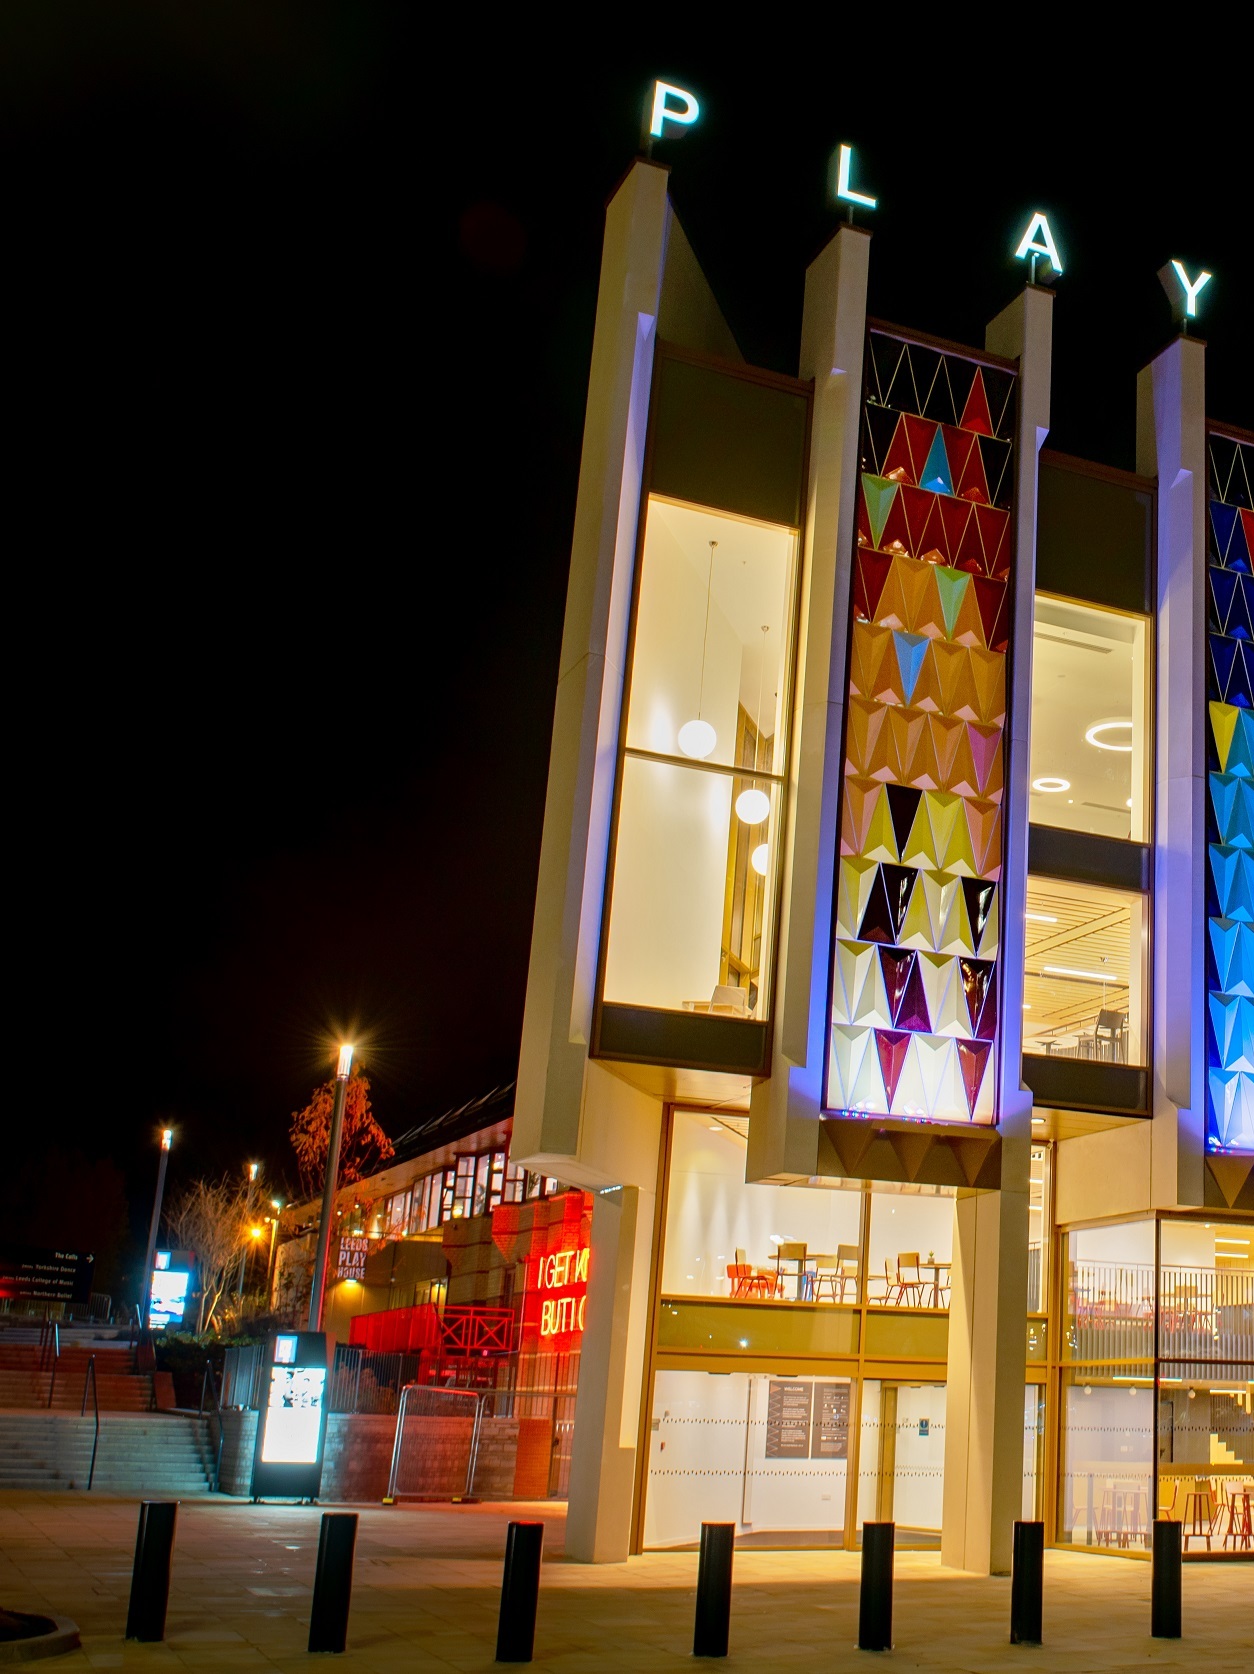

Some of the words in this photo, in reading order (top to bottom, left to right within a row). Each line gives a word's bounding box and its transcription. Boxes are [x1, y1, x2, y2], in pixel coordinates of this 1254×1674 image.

[341, 1237, 368, 1252] LEEDS
[55, 1251, 65, 1259] The
[65, 1252, 78, 1261] Calls
[339, 1251, 366, 1267] PLAY
[35, 1263, 60, 1272] Yorkshire
[60, 1265, 76, 1273] Dance
[338, 1267, 365, 1279] HOUSE
[538, 1257, 544, 1289] I
[545, 1250, 575, 1289] GET
[15, 1274, 31, 1282] Leeds
[32, 1276, 52, 1286] College
[52, 1278, 58, 1286] of
[58, 1279, 74, 1287] Music
[33, 1290, 56, 1298] Northern
[56, 1291, 73, 1299] Ballet
[541, 1298, 572, 1336] BUT
[570, 1298, 576, 1332] I
